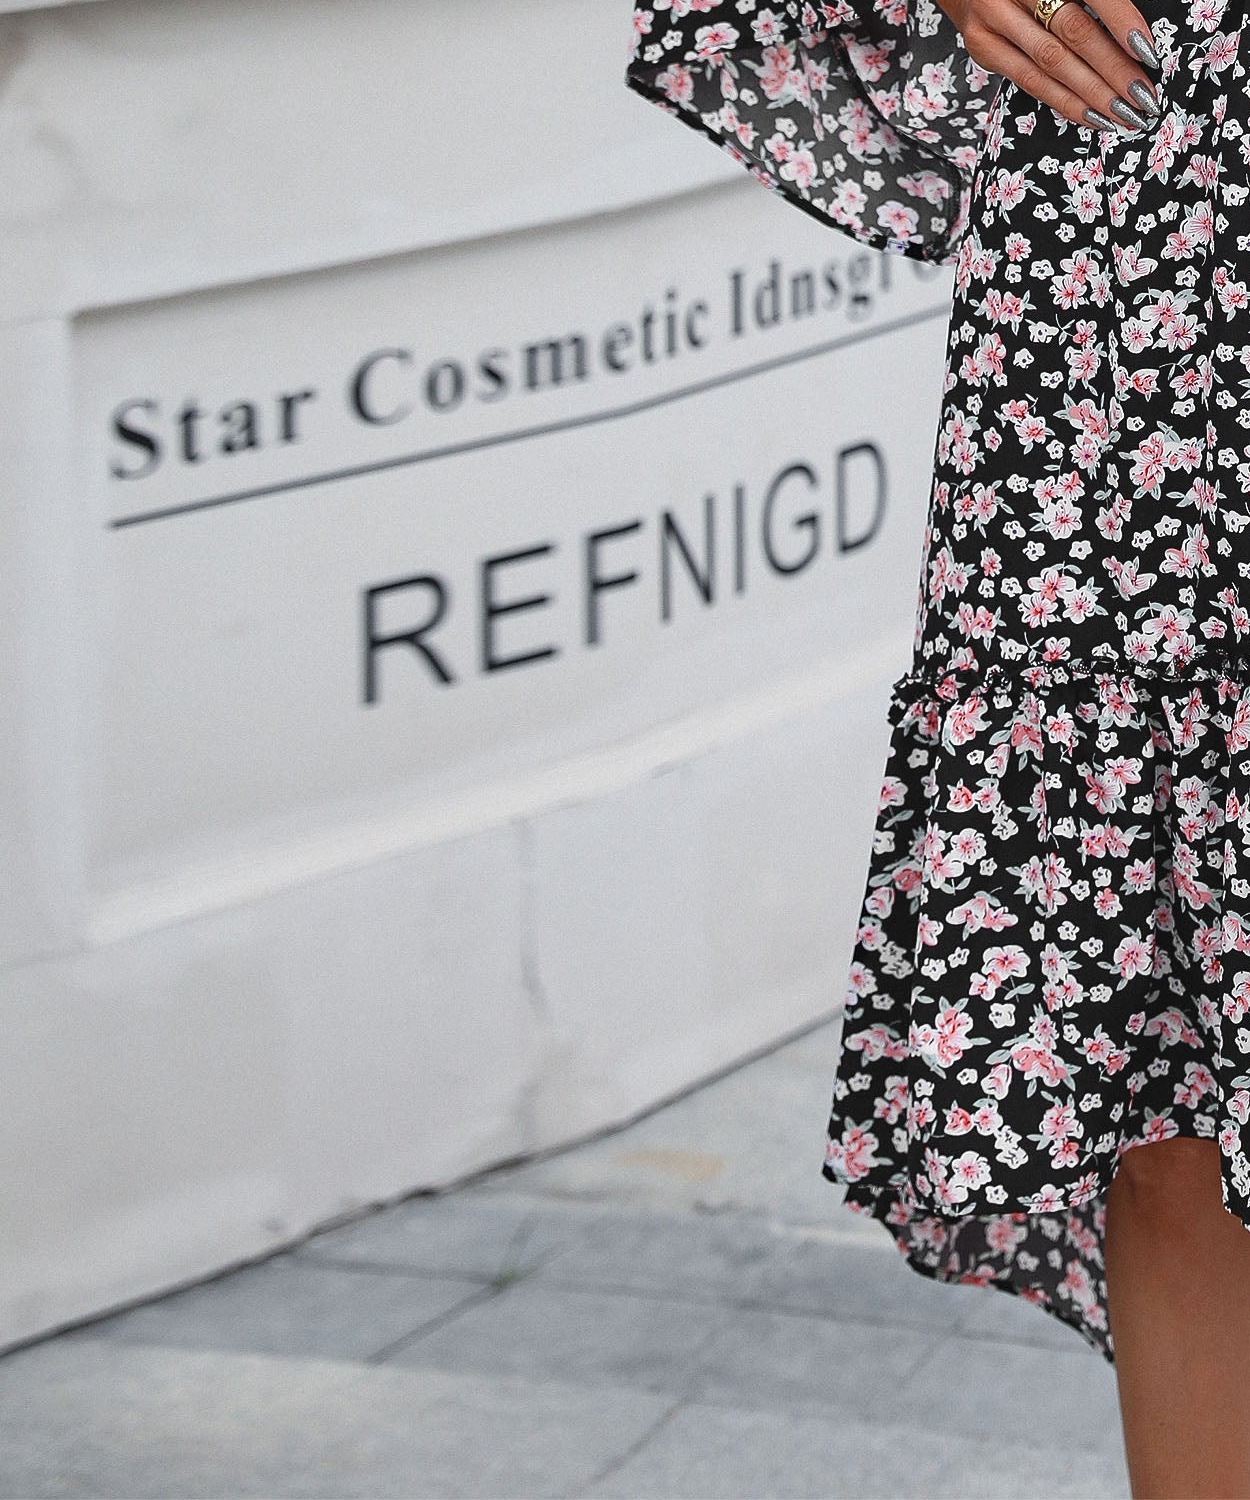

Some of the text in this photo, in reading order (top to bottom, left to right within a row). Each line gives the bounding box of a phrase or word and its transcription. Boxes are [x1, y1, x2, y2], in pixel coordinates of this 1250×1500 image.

[106, 389, 315, 482] Star
[348, 284, 710, 431] Cosmetic
[361, 439, 891, 705] REFNIGD
